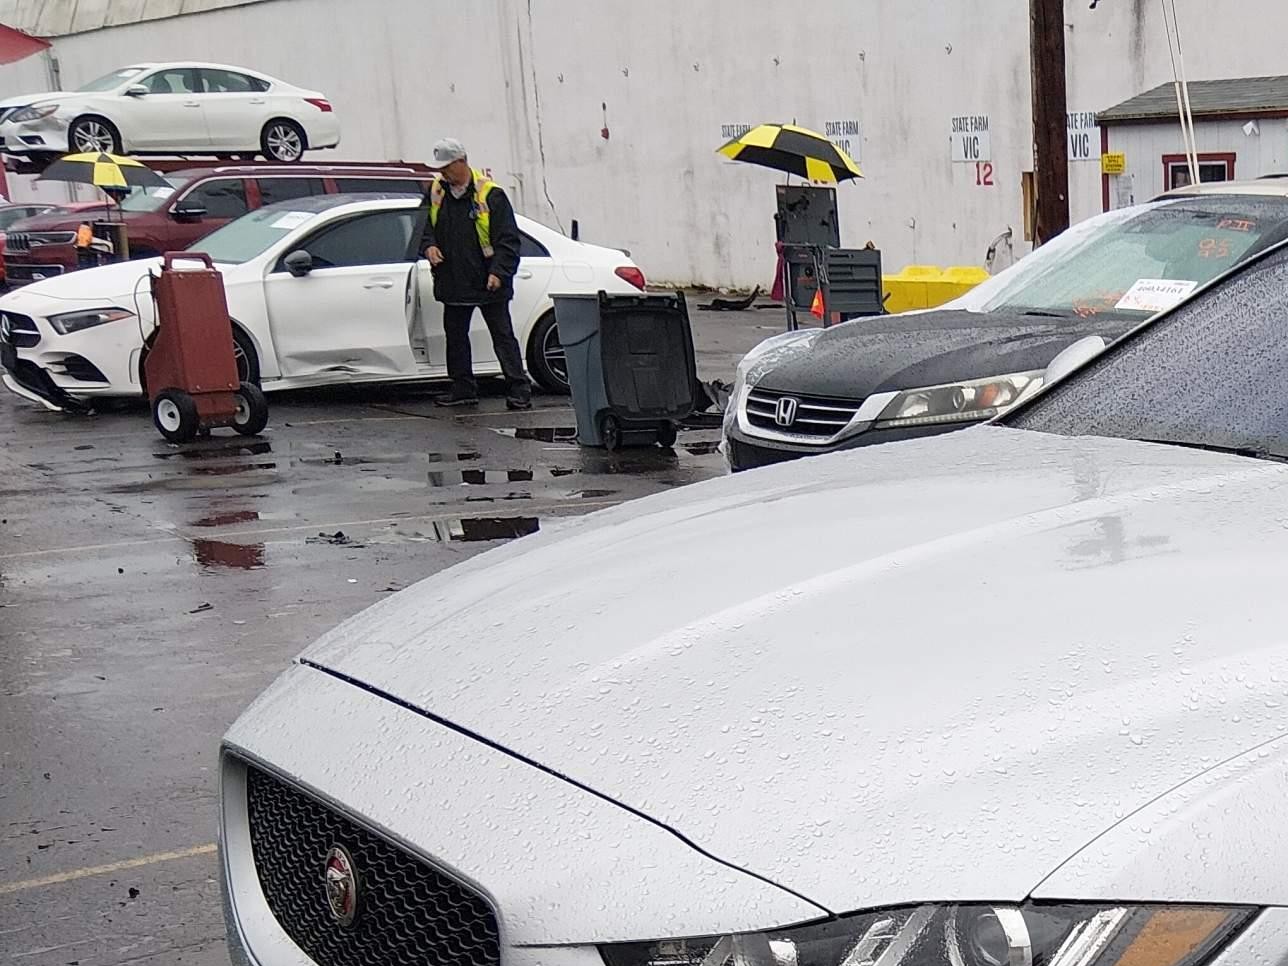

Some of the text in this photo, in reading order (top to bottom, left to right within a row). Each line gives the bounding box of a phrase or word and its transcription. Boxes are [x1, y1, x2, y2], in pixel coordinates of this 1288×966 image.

[825, 120, 859, 136] STATE FARM
[952, 115, 989, 132] STATE FARM
[1067, 113, 1079, 129] ATE
[962, 136, 979, 159] VIC
[1070, 133, 1089, 158] VIC
[976, 160, 994, 186] 12
